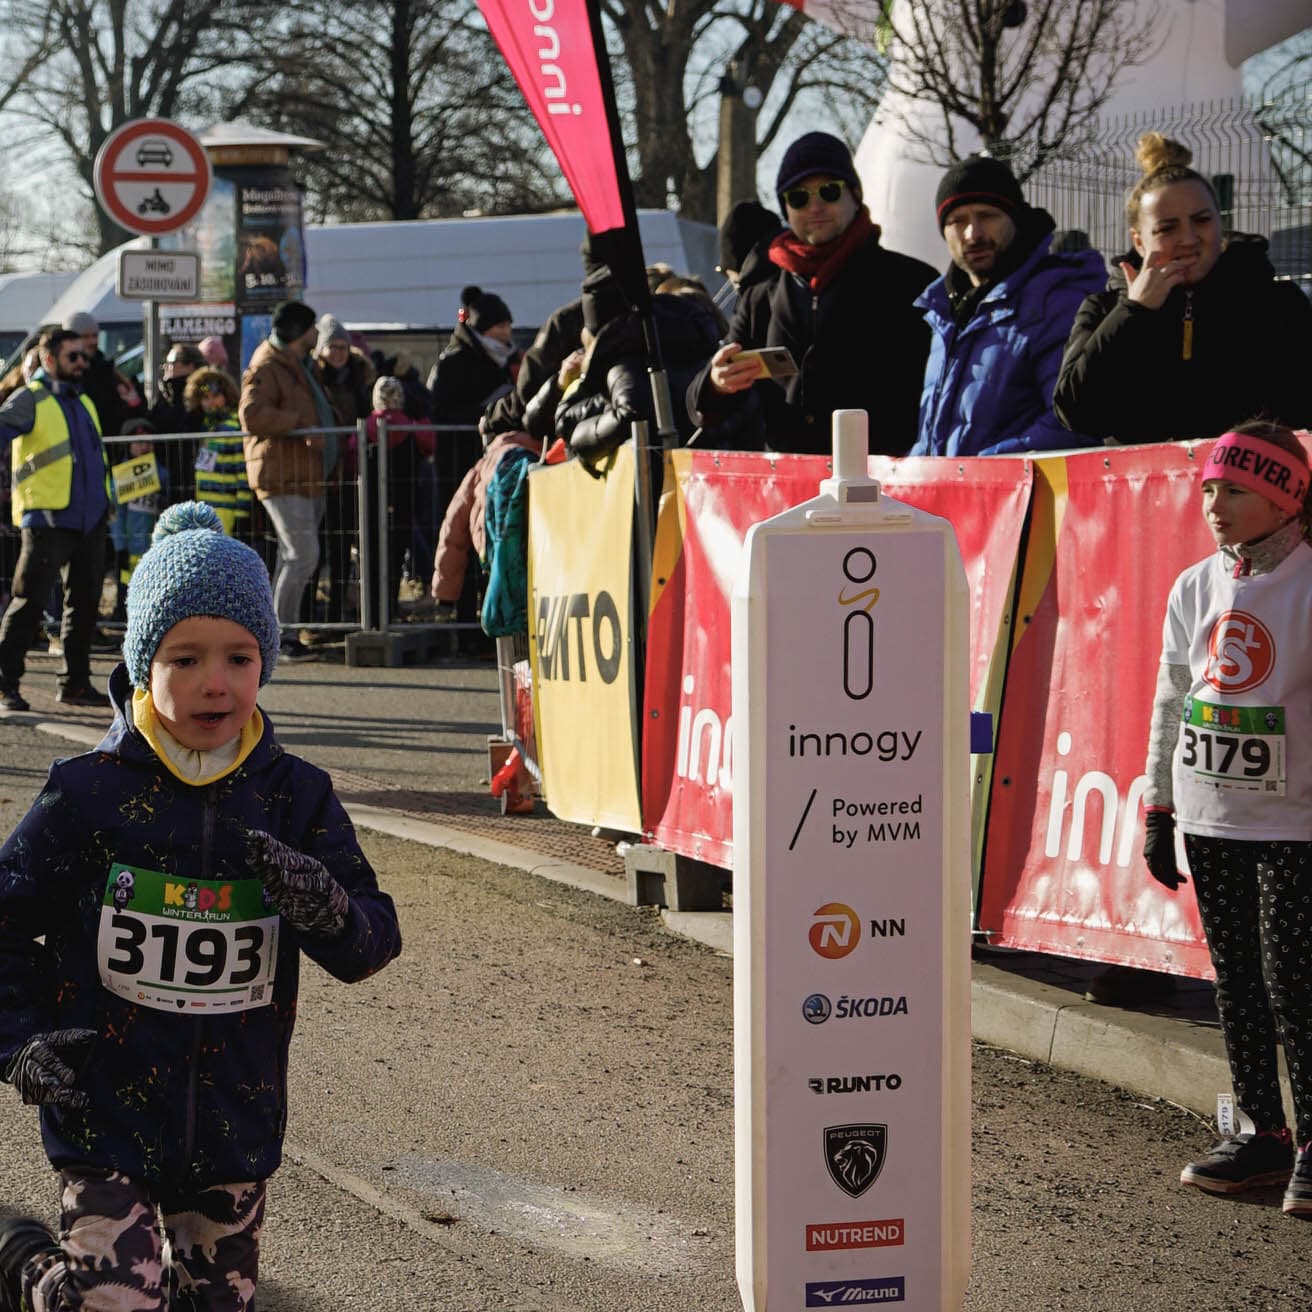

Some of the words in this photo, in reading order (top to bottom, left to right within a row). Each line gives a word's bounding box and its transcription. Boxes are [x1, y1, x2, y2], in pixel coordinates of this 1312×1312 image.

[789, 725, 923, 762] innogy
[1182, 728, 1271, 777] 3179
[832, 794, 923, 818] Powered
[832, 823, 859, 849] by
[867, 821, 921, 843] MVM
[870, 918, 906, 938] NN
[107, 914, 264, 986] 3193
[835, 995, 909, 1019] ŠKODA
[826, 1074, 903, 1094] RUNTO
[829, 1130, 882, 1140] PEUGEOT
[811, 1225, 900, 1245] NUTREND
